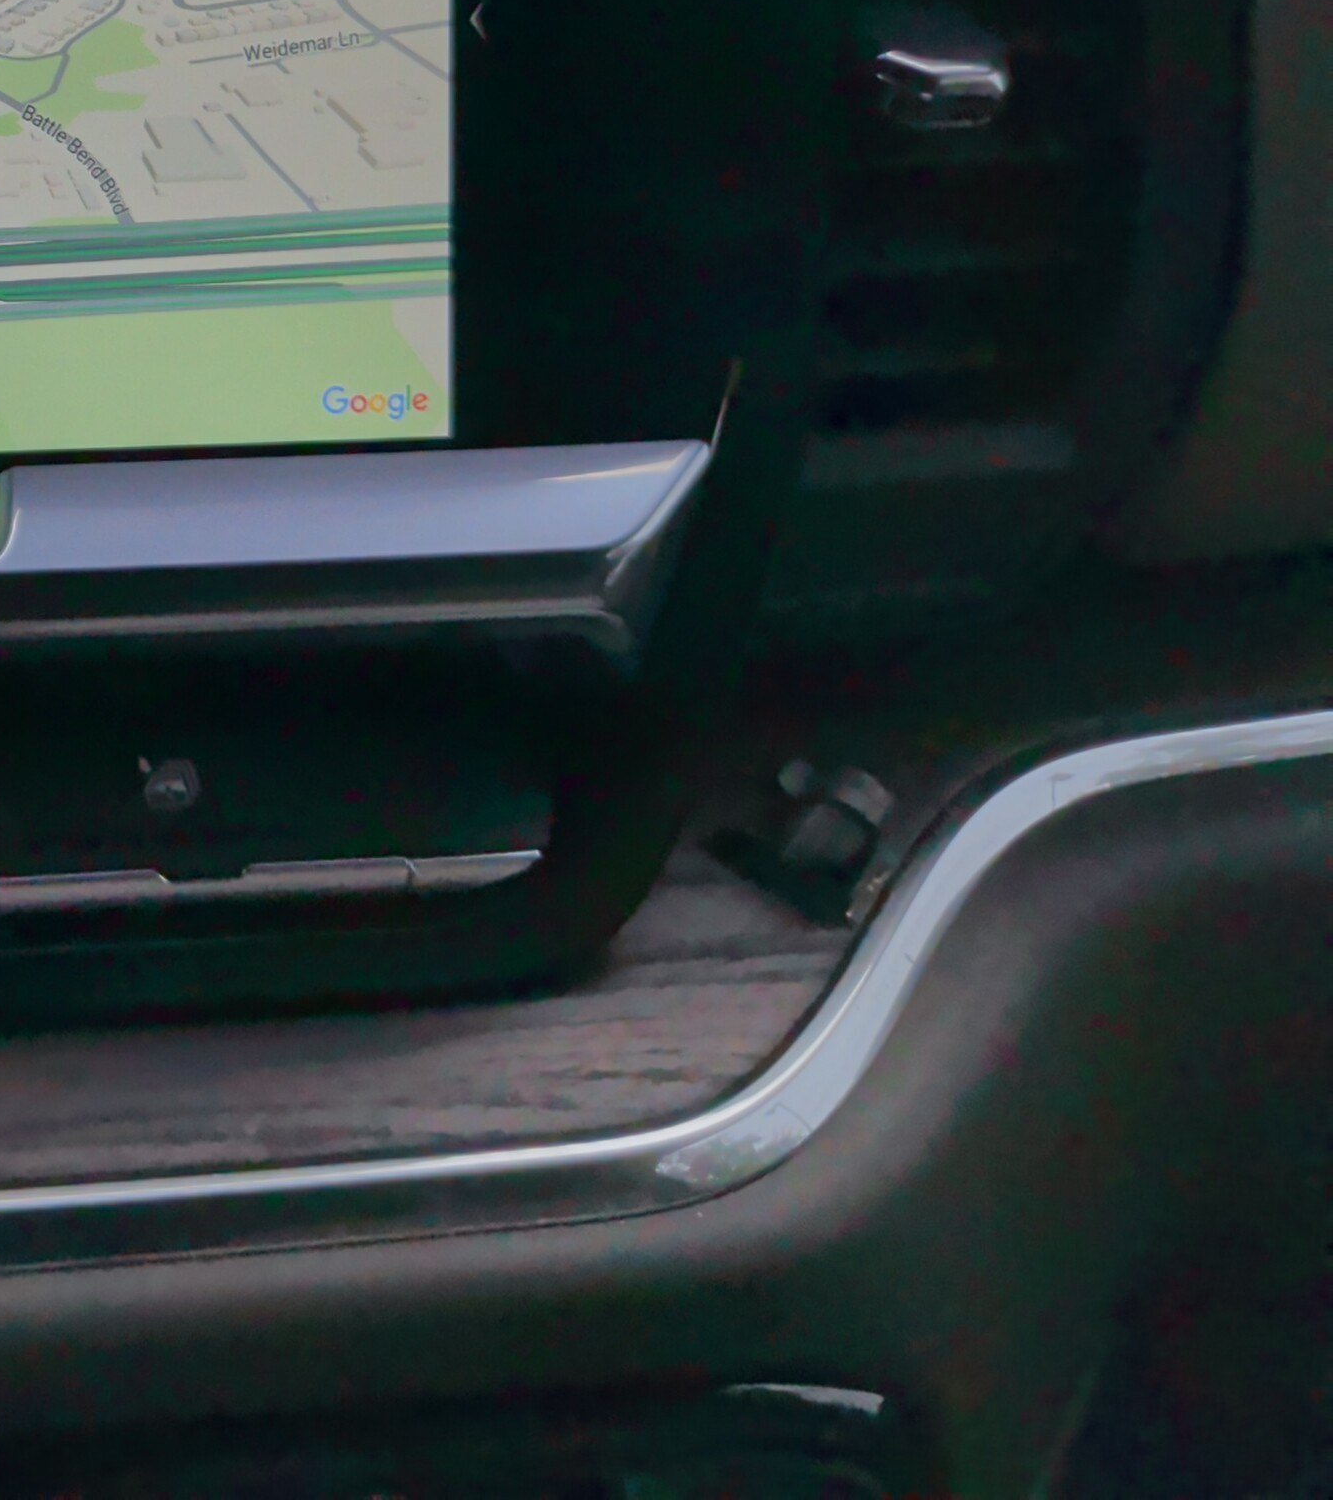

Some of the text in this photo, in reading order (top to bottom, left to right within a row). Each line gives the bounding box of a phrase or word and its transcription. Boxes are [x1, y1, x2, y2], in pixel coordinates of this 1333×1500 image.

[243, 31, 360, 62] Weidemar Ln
[21, 104, 130, 216] Battle Bend Blvd
[322, 384, 429, 420] Google
